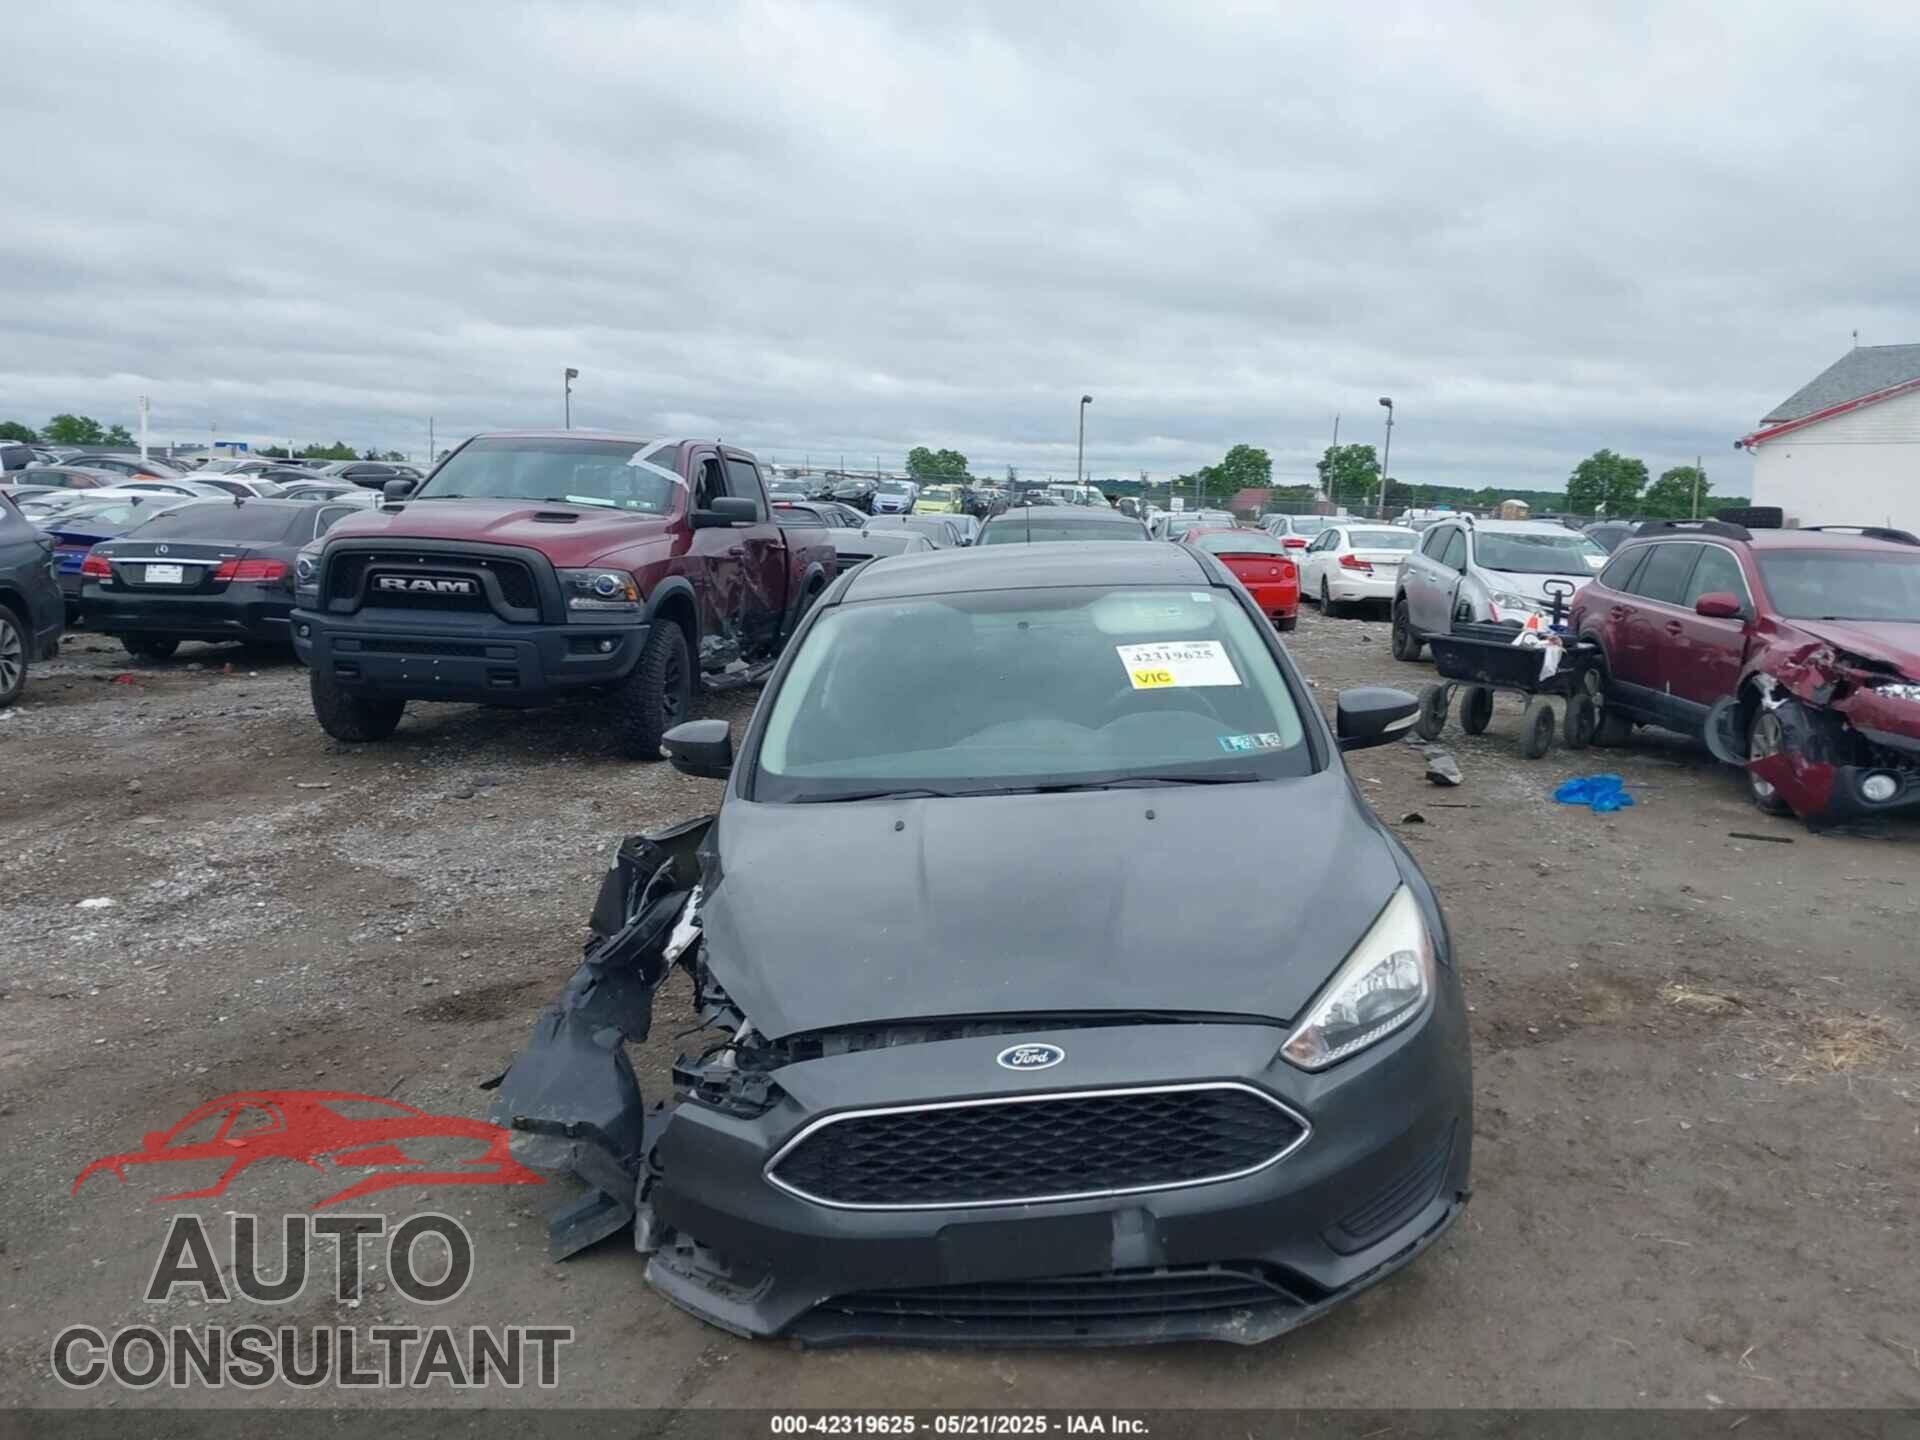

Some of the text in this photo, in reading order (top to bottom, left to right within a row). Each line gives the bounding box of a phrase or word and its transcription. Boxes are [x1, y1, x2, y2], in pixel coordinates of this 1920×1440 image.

[380, 578, 469, 592] RAM
[1134, 650, 1214, 662] 42319625
[1135, 672, 1171, 683] VIC
[1012, 1048, 1048, 1065] Ford
